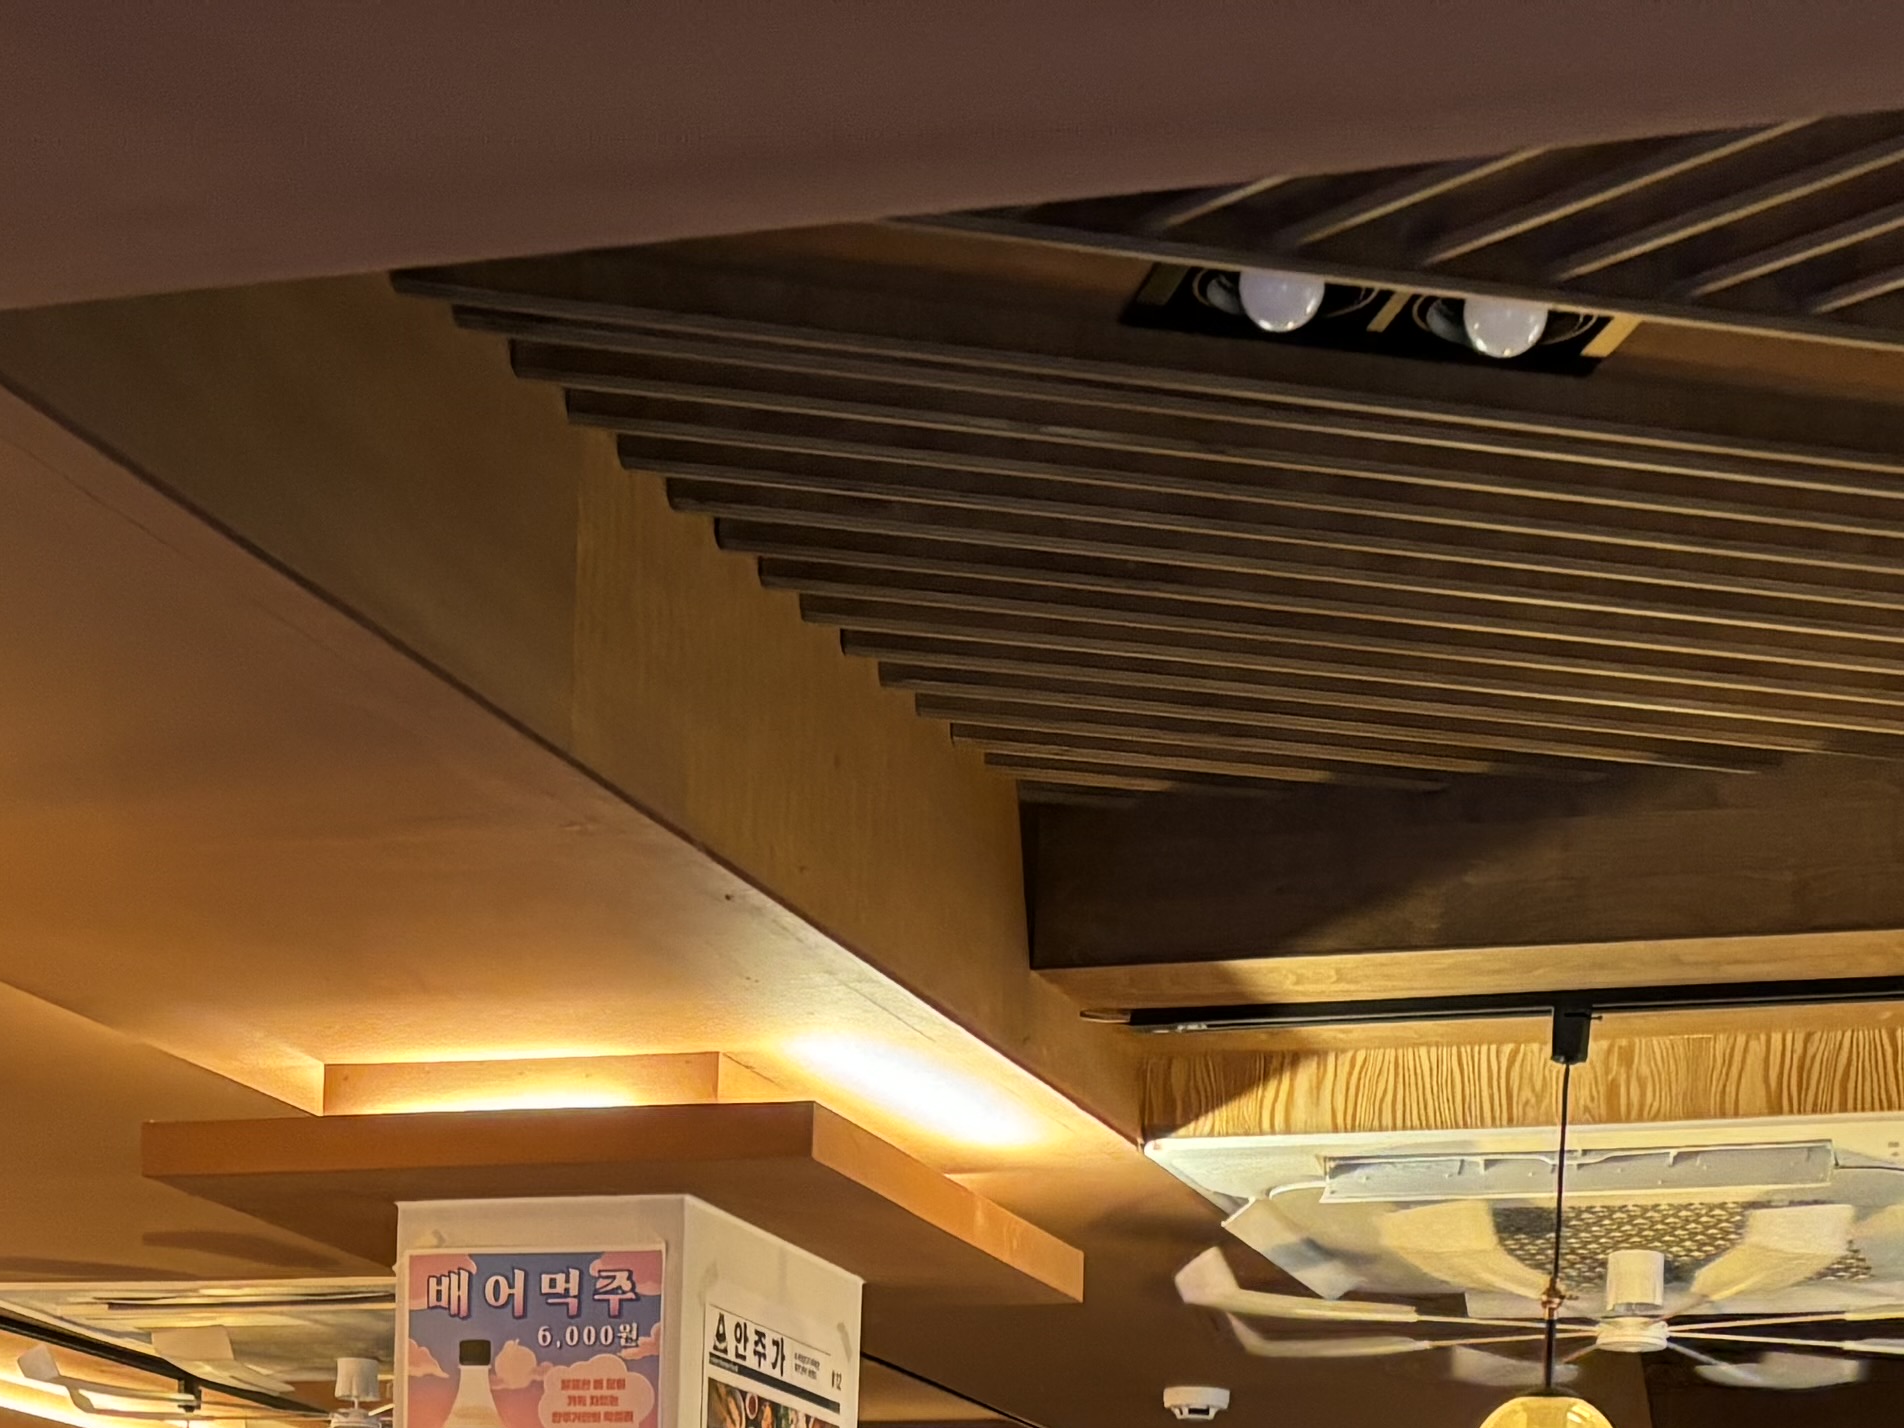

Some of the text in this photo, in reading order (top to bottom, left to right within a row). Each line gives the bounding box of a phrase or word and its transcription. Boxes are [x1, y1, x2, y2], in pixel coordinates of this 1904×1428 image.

[427, 1266, 638, 1320] 배어먹주
[536, 1322, 640, 1350] 6,000원
[733, 1321, 786, 1378] 안주가
